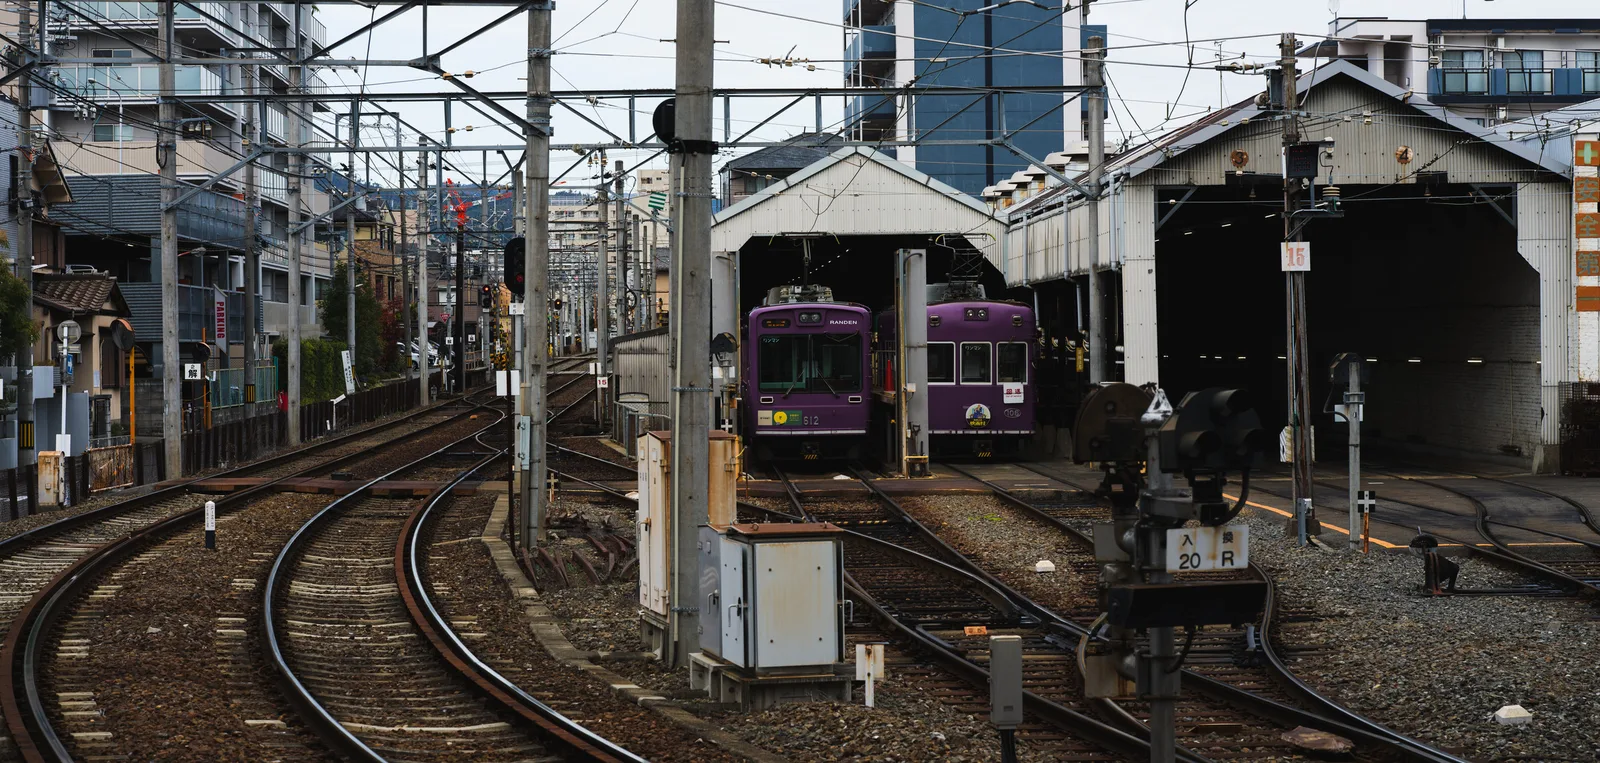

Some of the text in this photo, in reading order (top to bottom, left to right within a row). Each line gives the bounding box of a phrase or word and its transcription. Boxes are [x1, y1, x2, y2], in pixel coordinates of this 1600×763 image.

[1234, 151, 1244, 164] 3
[1400, 148, 1409, 160] 4
[1576, 178, 1600, 301] 安全第一
[1287, 247, 1305, 267] 15
[216, 301, 226, 339] PARKING
[188, 369, 198, 378] 解
[803, 416, 819, 425] 612
[1182, 534, 1193, 546] 入
[1179, 550, 1234, 570] 20 R
